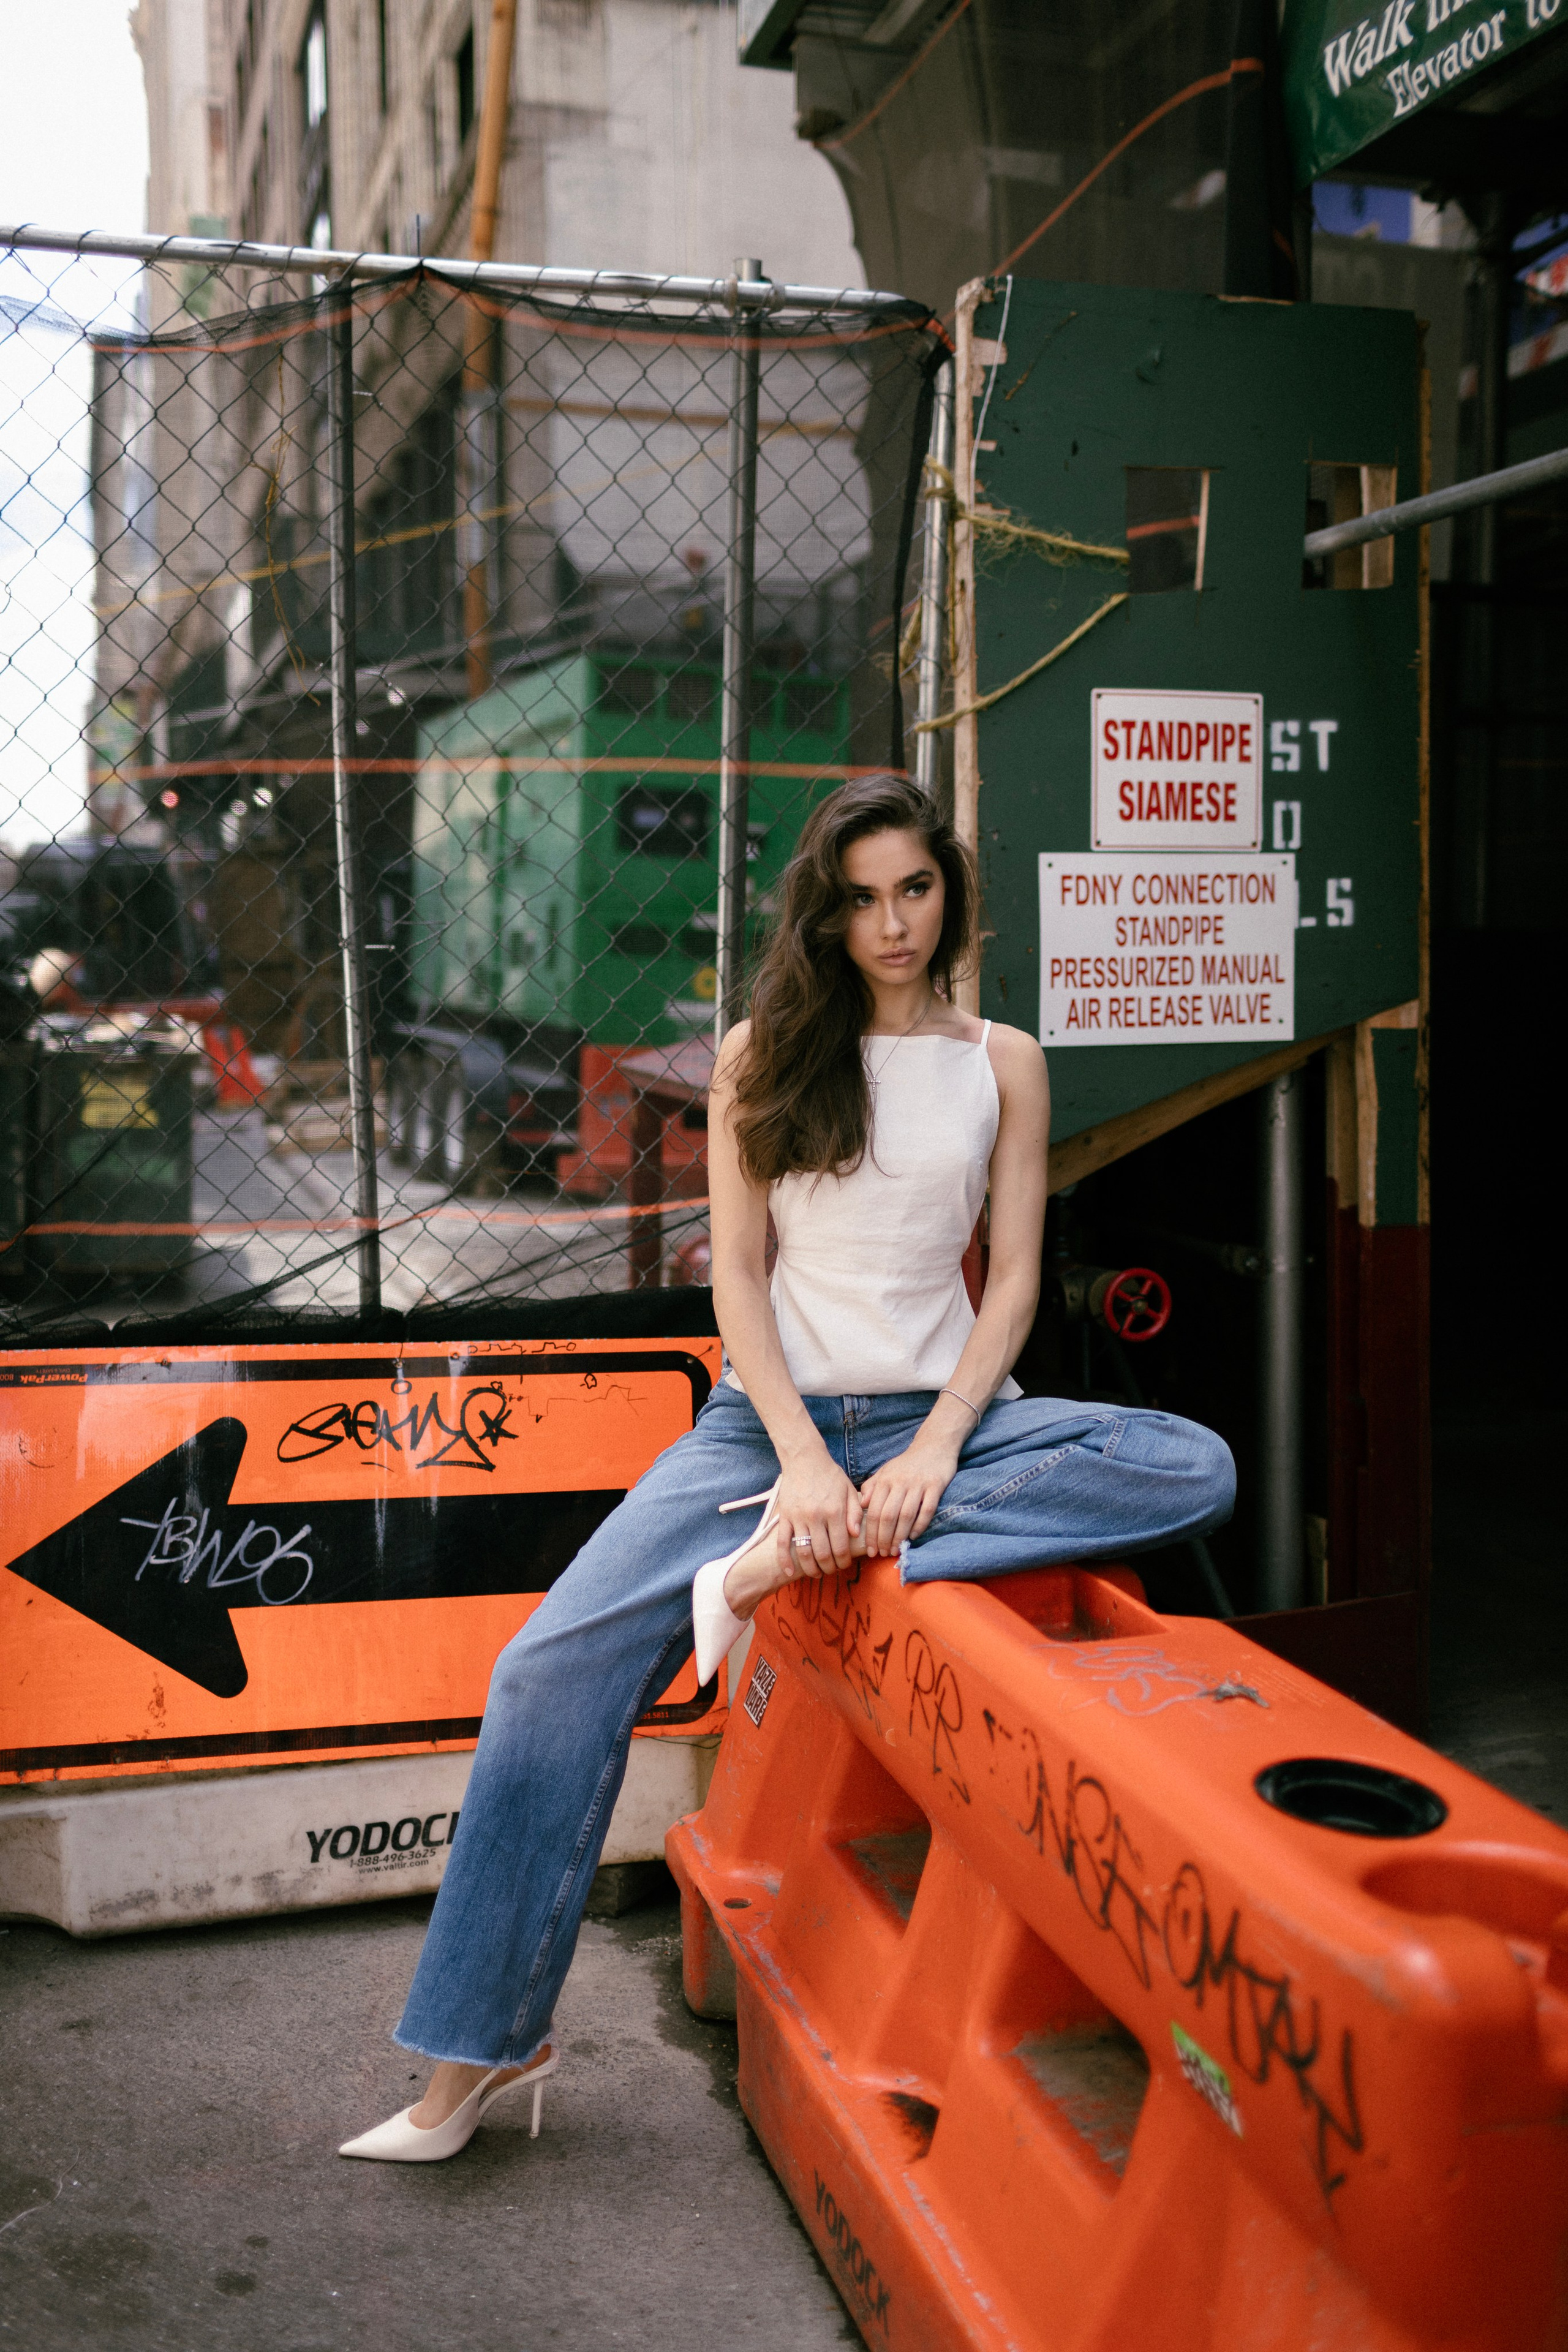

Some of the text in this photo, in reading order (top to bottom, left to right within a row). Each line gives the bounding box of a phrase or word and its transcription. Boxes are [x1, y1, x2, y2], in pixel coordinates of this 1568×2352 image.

[1323, 0, 1416, 98] Walk
[1385, 8, 1507, 119] Elevator
[1103, 719, 1252, 763] STANDPIPE
[1118, 780, 1237, 822] SIAMESE
[1061, 873, 1276, 906] FDNY CONNECTION
[1115, 915, 1224, 947] STANDPIPE
[1050, 954, 1286, 989] PRESSURIZED MANUAL
[1066, 993, 1272, 1029] AIR RELEASE VALVE
[20, 1373, 88, 1384] PowerPak
[349, 1847, 436, 1869] 1-888-496-3625
[358, 1859, 429, 1875] www.valtir.com
[813, 2167, 891, 2339] YODOCK
